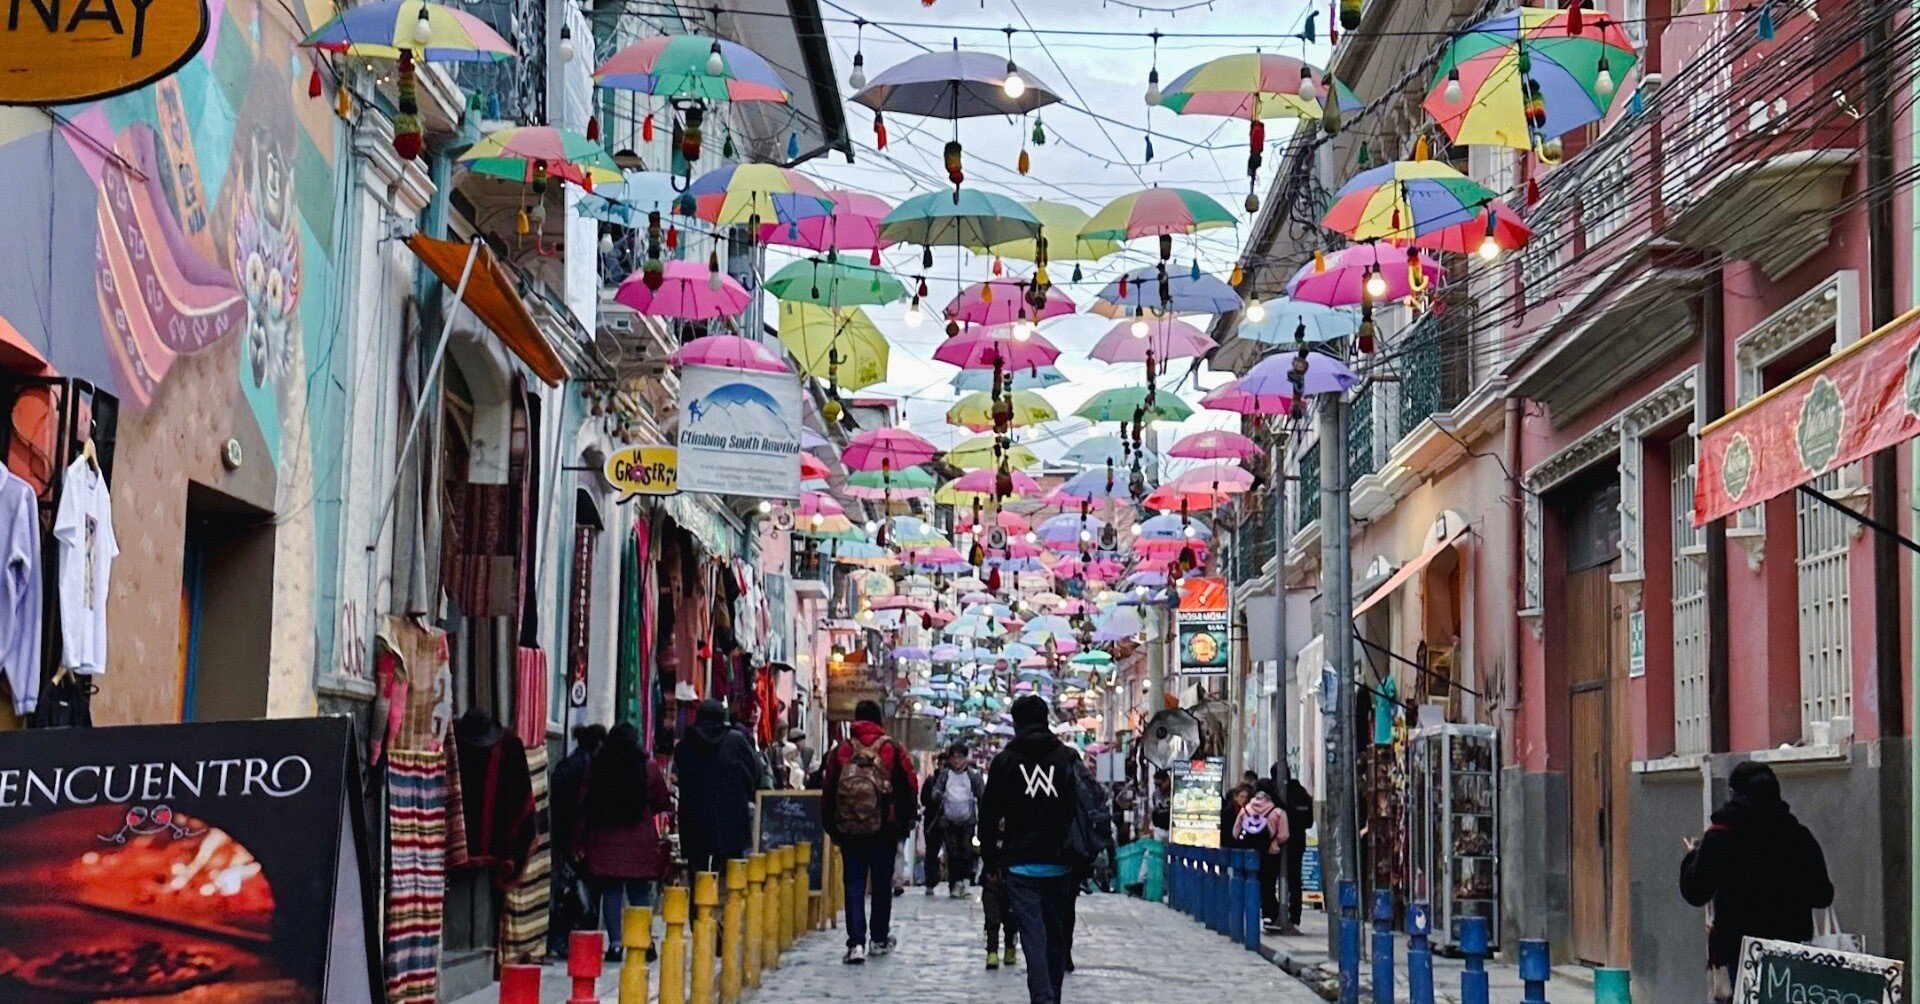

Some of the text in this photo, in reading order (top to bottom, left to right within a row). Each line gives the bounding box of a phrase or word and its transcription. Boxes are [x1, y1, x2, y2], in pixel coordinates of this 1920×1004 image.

[680, 430, 727, 449] Climbing
[729, 434, 760, 450] South
[761, 437, 801, 454] America
[633, 450, 643, 464] LA
[0, 755, 312, 808] ENCUENTRO
